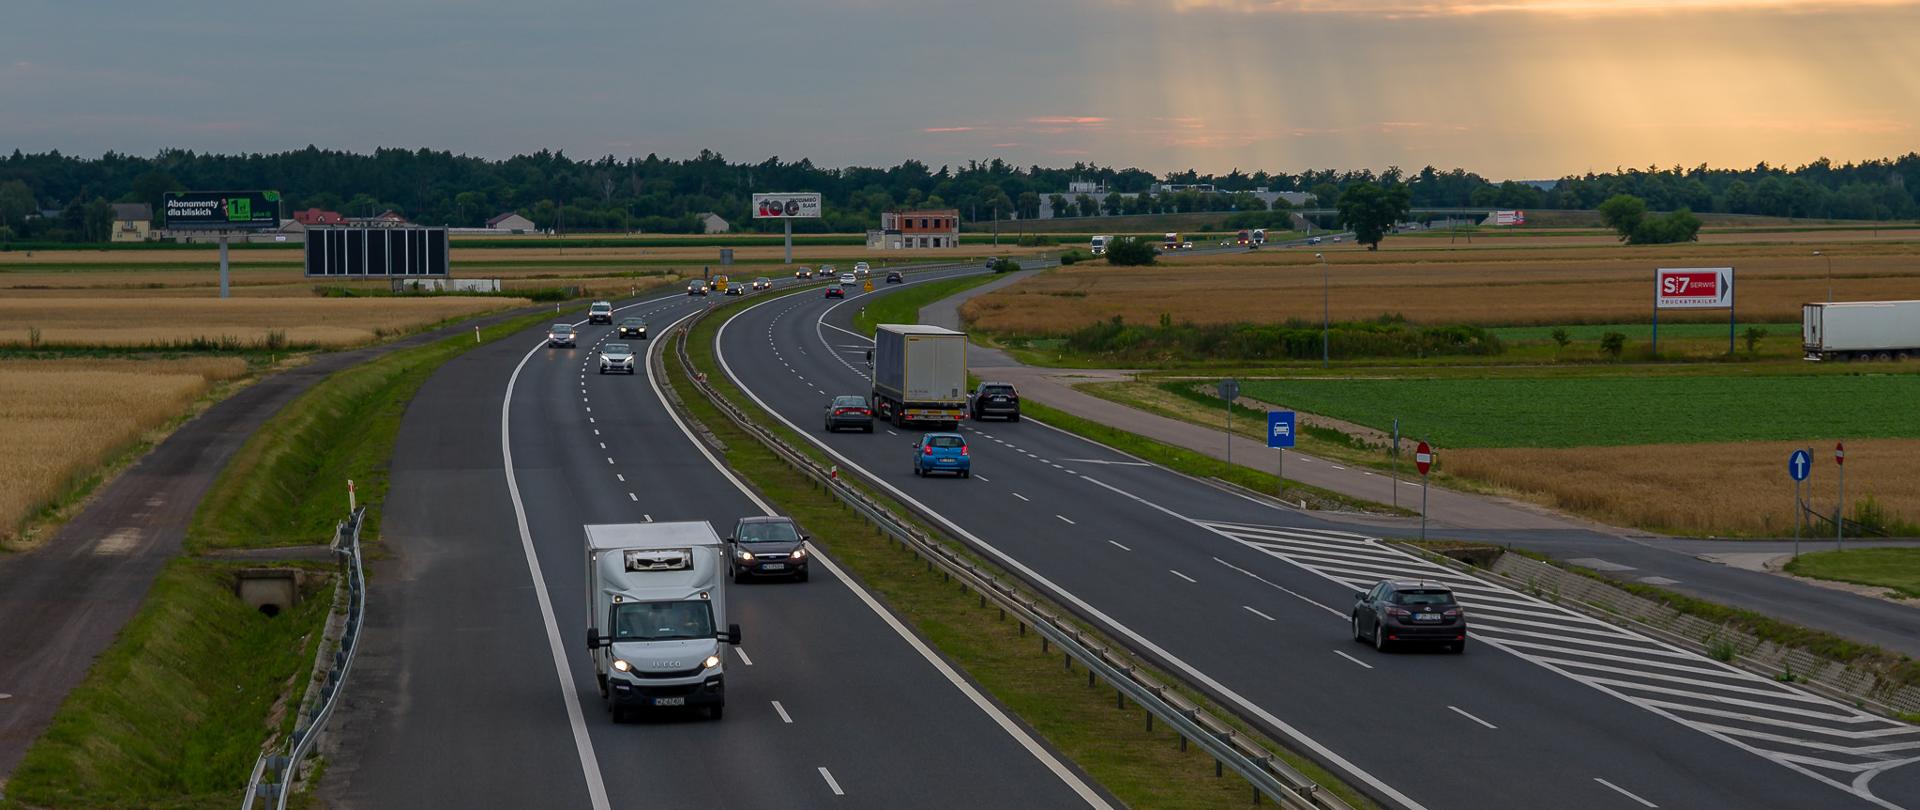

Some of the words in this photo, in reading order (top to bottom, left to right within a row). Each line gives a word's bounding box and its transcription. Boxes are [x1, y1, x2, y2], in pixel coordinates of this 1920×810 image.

[168, 200, 218, 208] Abonamenty
[230, 200, 239, 214] 1
[168, 208, 180, 216] dla
[182, 208, 211, 216] bliskich
